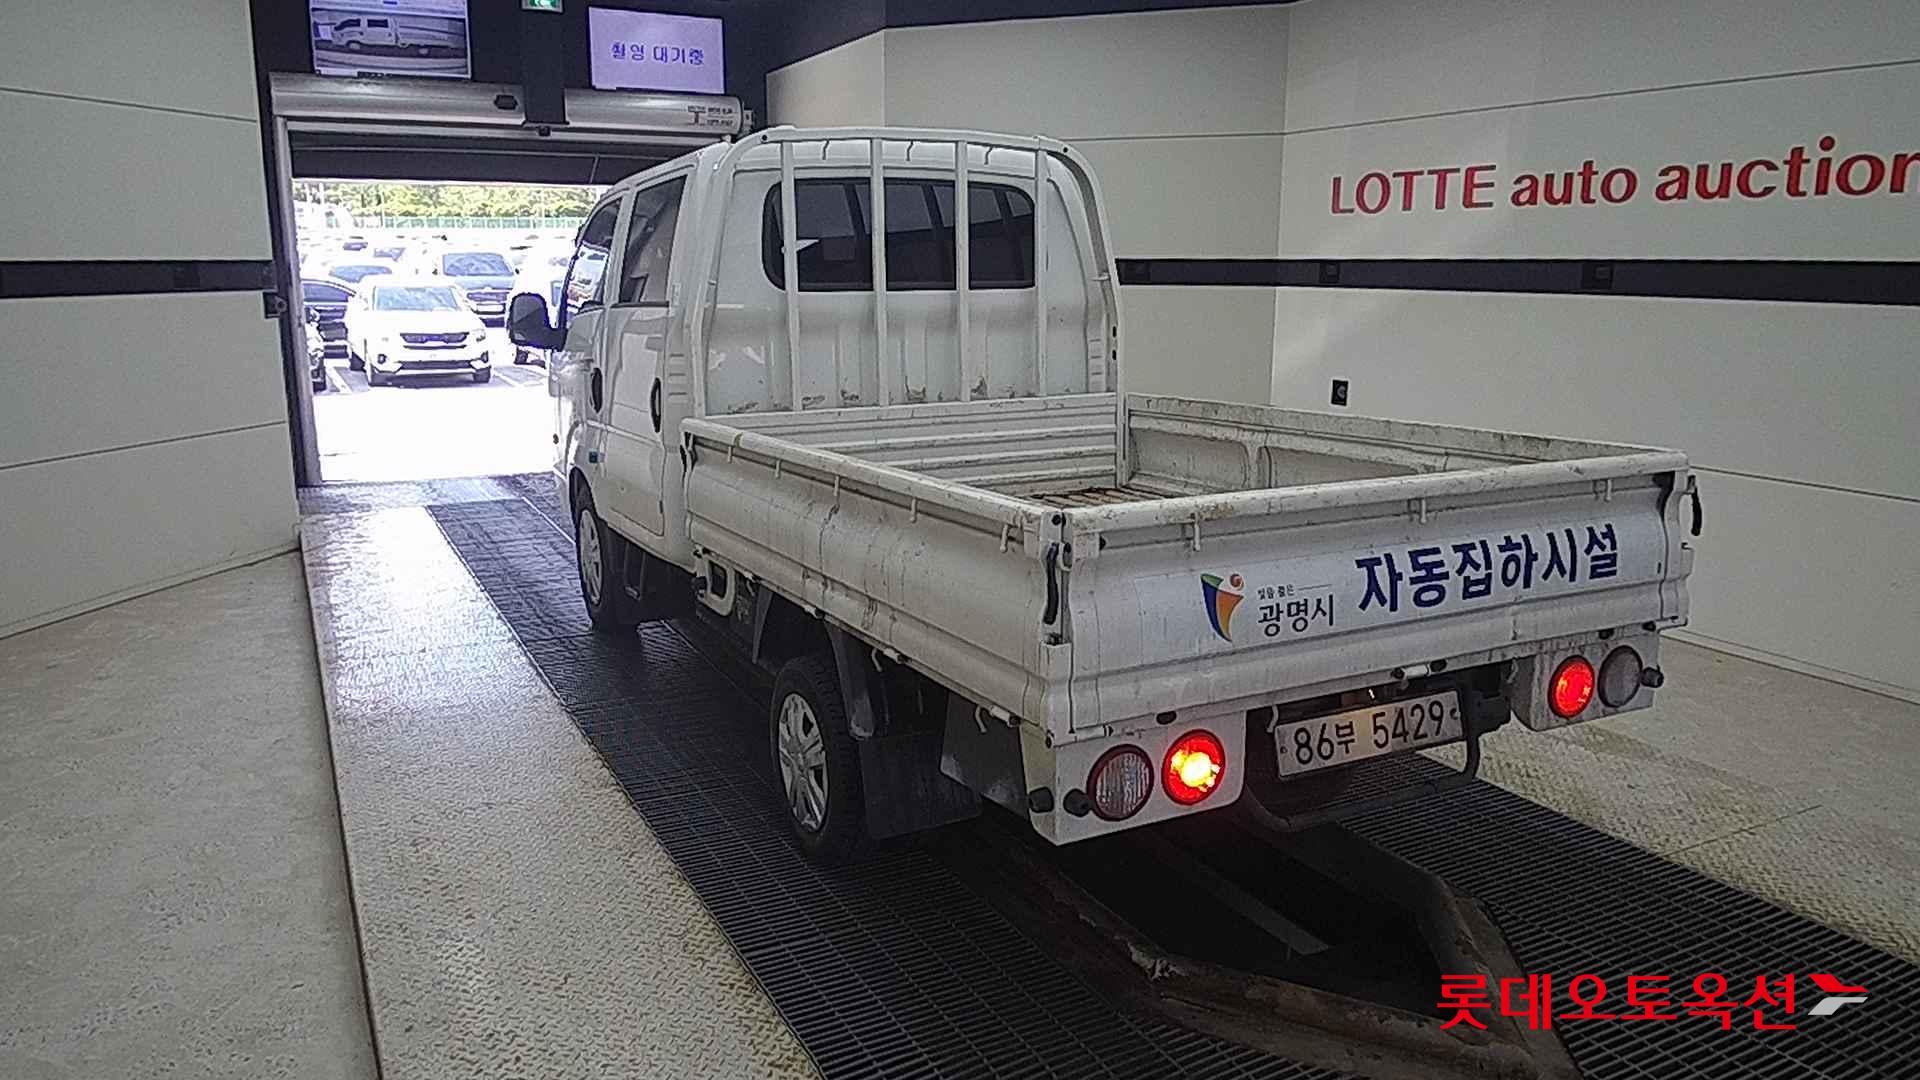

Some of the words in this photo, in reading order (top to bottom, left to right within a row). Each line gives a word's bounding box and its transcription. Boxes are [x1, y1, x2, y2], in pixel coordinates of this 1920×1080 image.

[653, 46, 705, 66] 대기중
[1330, 164, 1497, 215] LOTTE
[1510, 160, 1638, 207] auto
[1354, 523, 1618, 613] 자동집하시설
[1258, 594, 1334, 637] 광명시
[1293, 721, 1356, 765] 86부
[1371, 700, 1445, 749] 5429
